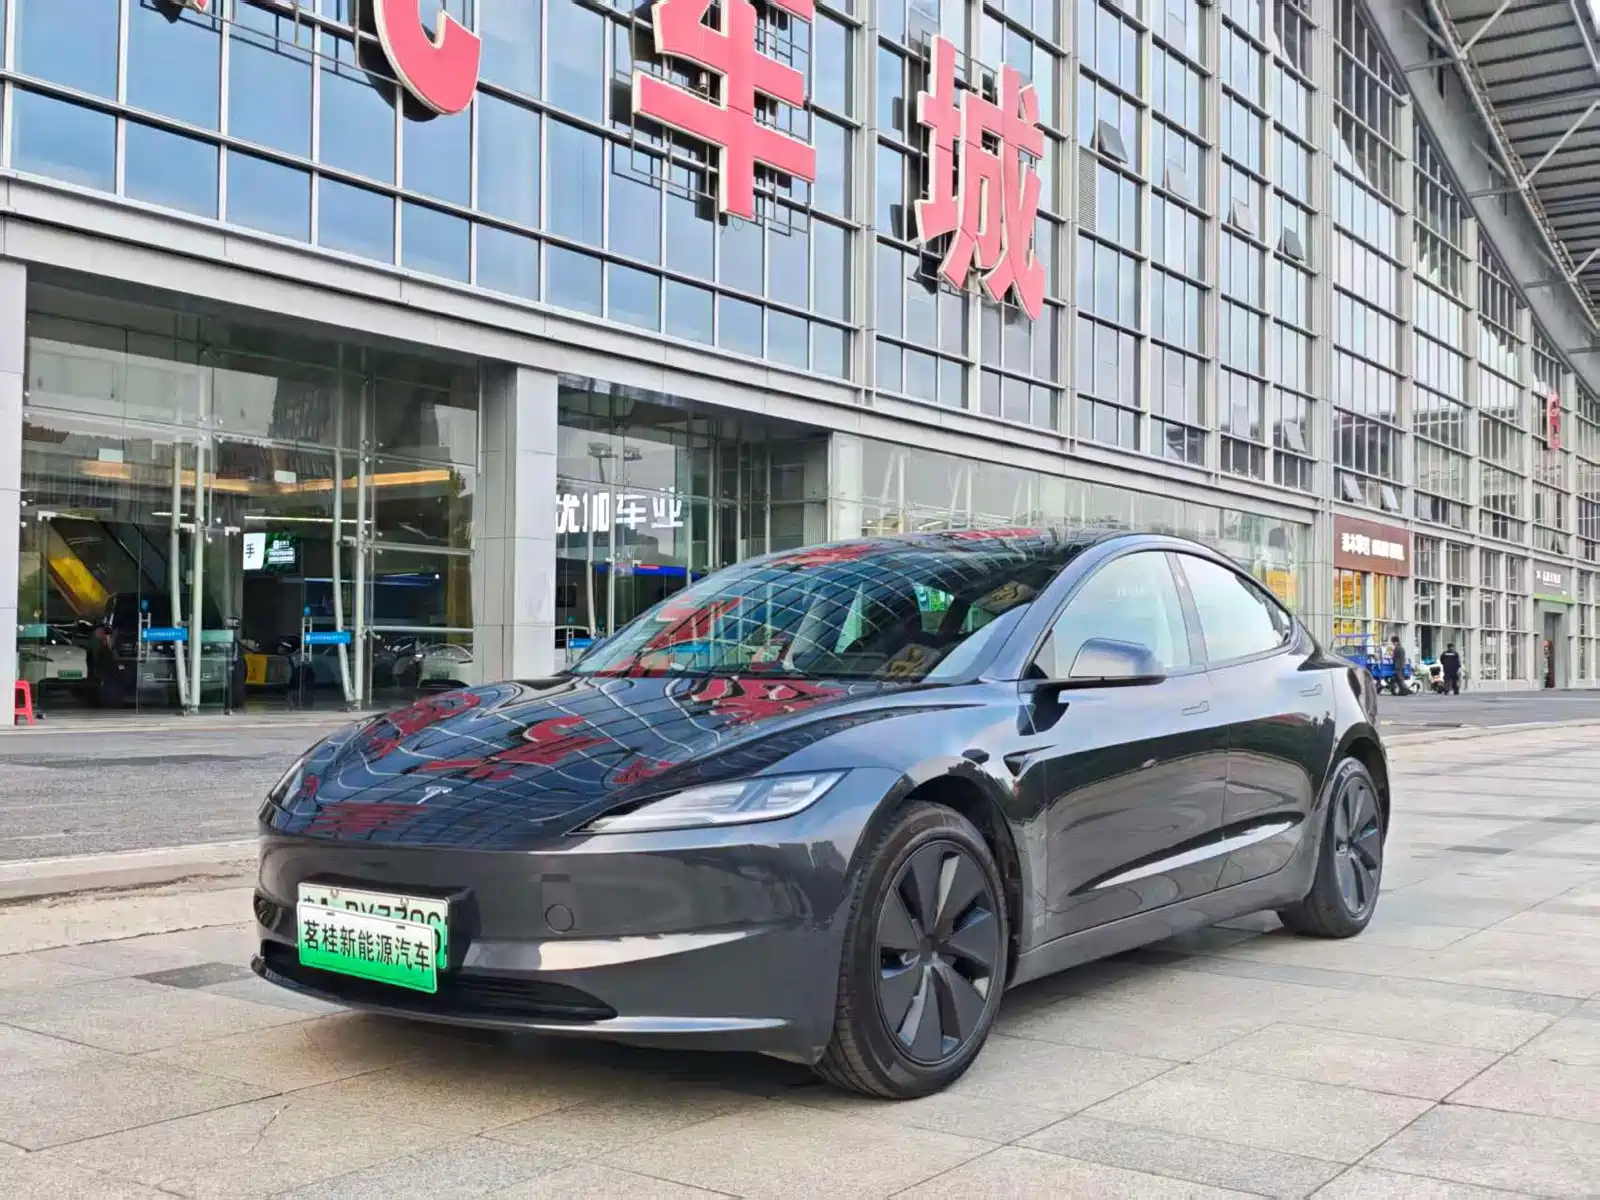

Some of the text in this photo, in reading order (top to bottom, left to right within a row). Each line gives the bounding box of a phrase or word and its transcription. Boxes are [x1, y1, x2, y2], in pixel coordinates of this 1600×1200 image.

[303, 918, 430, 974] 茗桂新能源汽车
